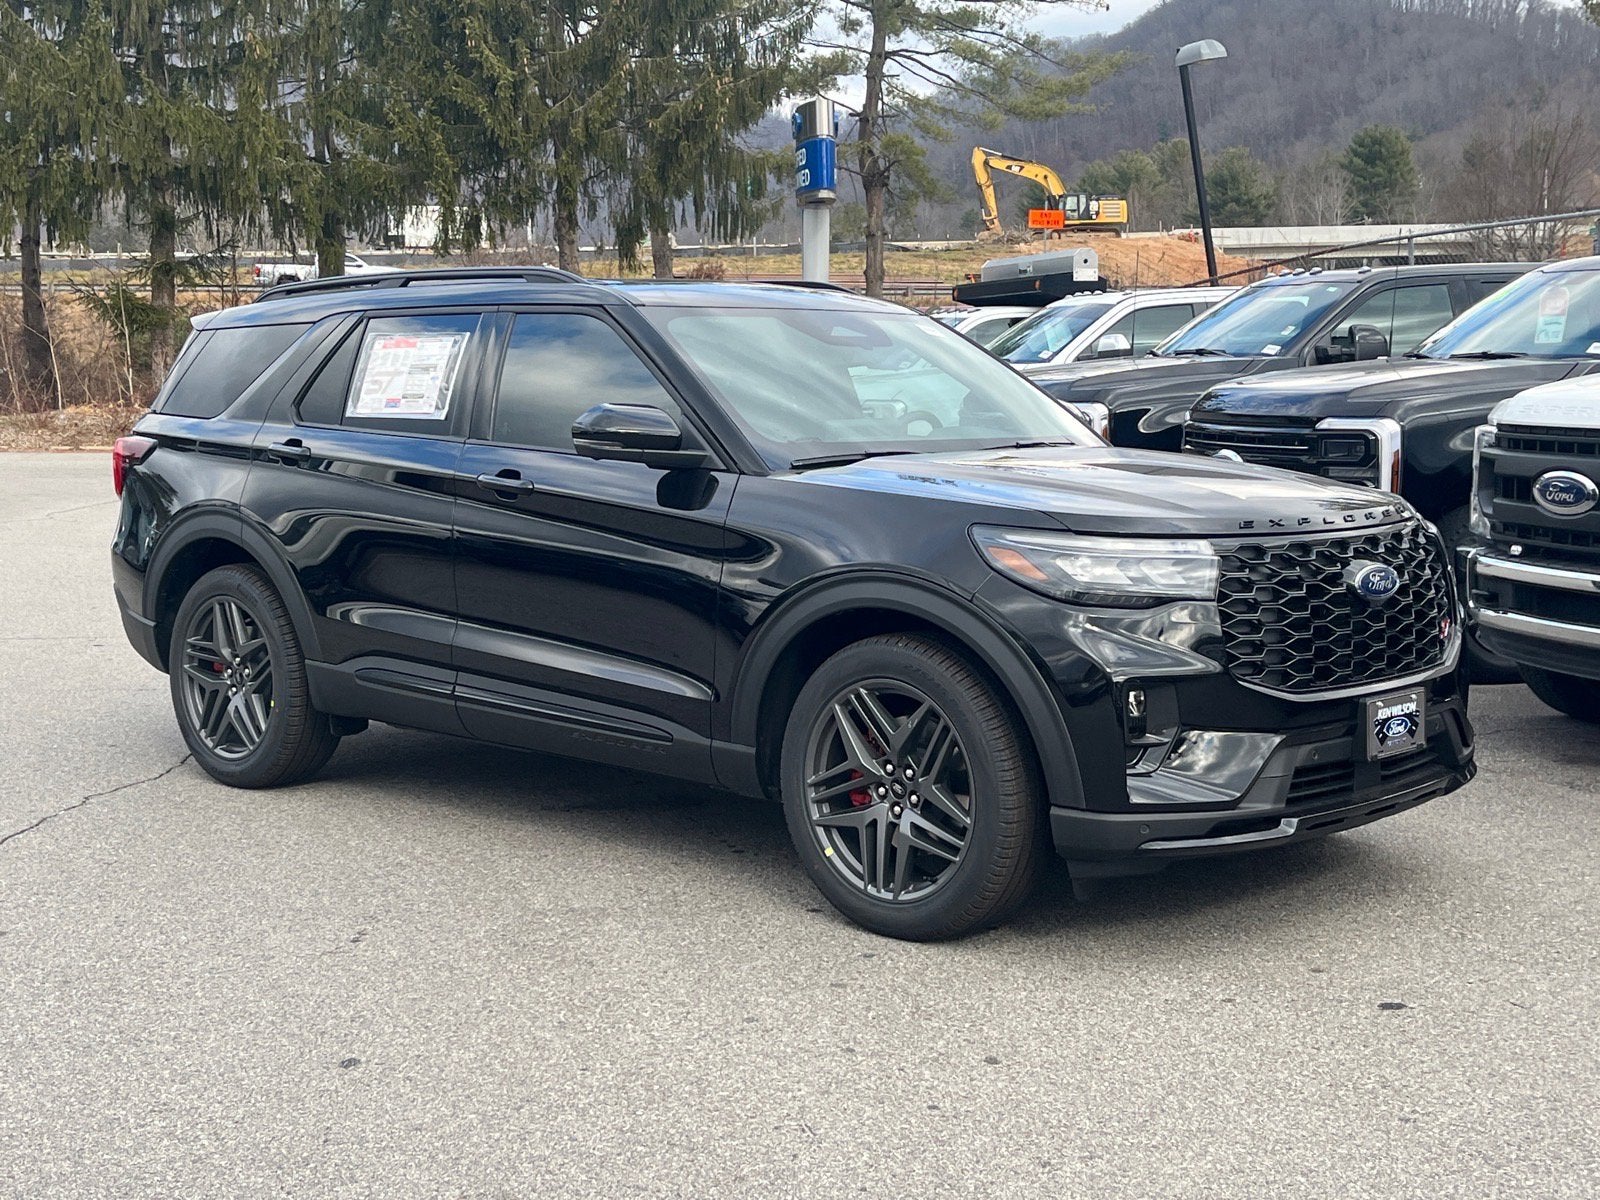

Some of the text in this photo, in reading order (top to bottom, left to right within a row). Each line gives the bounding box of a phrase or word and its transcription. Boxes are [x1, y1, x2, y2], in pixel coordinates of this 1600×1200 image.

[1546, 481, 1577, 502] Ford
[1238, 502, 1406, 529] EXPLORER
[1369, 571, 1394, 592] Ford
[1392, 701, 1417, 717] WILSON
[1388, 719, 1406, 736] Ford
